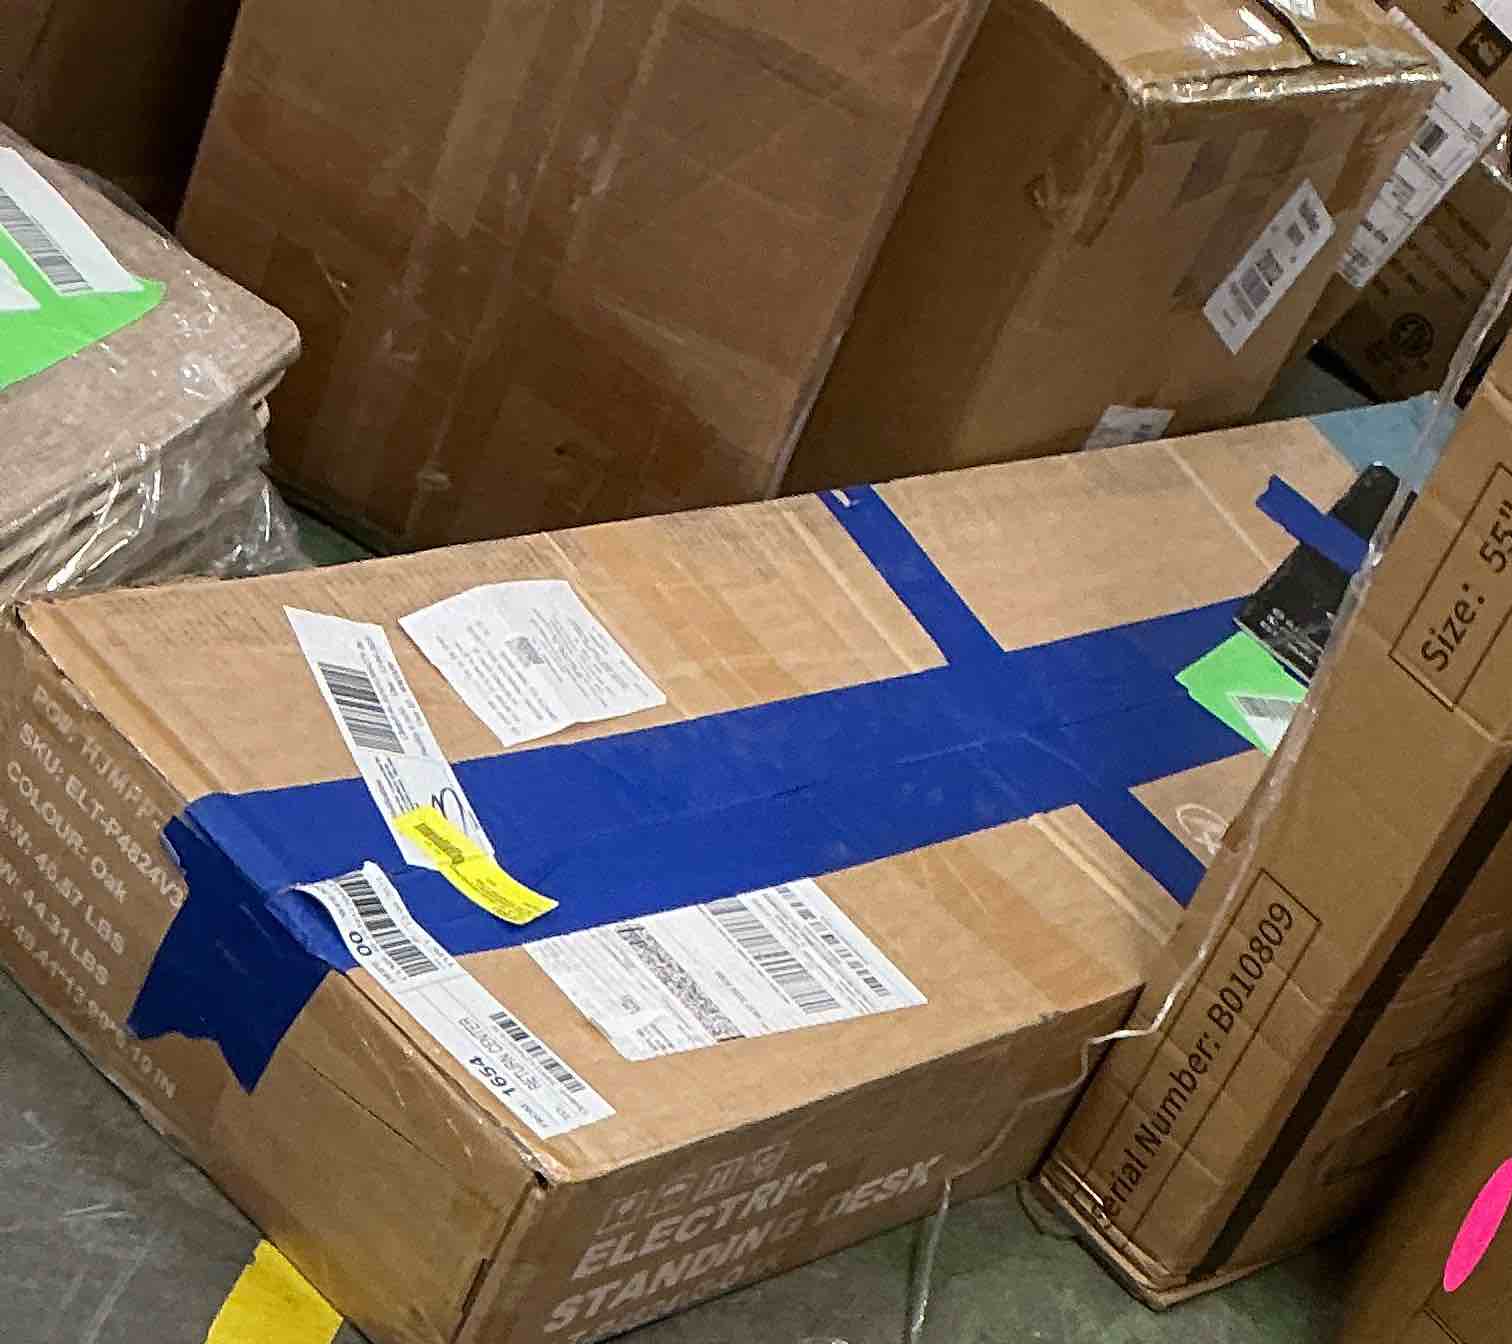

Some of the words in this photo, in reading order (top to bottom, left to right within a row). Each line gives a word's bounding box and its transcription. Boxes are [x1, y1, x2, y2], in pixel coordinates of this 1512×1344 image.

[1420, 581, 1486, 673] Size:
[7, 760, 88, 861] COLOUR:
[90, 855, 128, 904] Oak
[348, 930, 373, 957] 00
[469, 1055, 516, 1098] 1654
[1134, 1033, 1222, 1155] Number:
[1207, 901, 1295, 1035] B010809
[543, 1208, 808, 1334] STANDING
[570, 1161, 829, 1280] ELECTRIC
